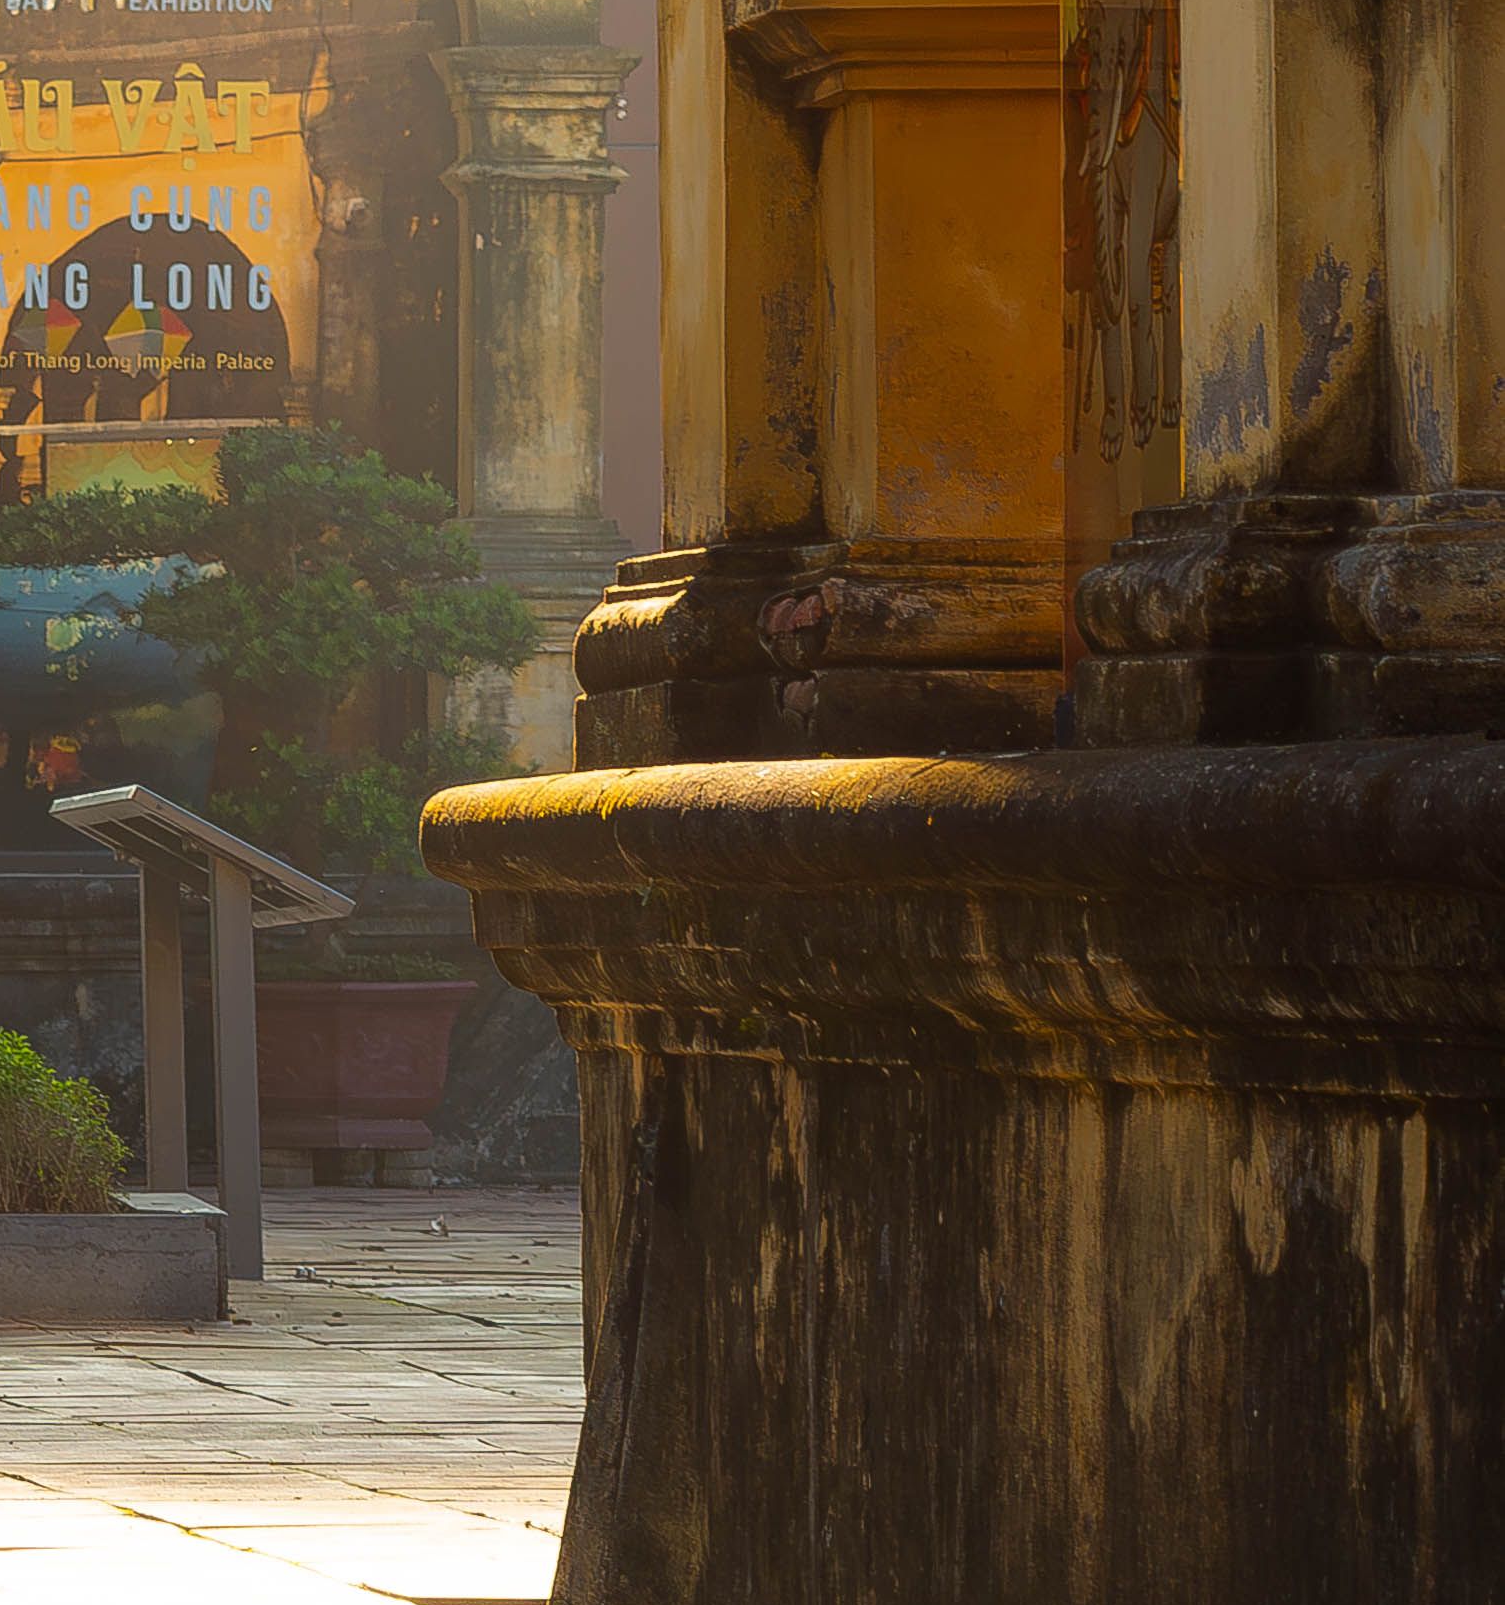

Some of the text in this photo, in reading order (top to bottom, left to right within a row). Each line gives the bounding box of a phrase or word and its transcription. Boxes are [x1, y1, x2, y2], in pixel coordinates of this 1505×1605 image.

[101, 62, 270, 171] VẬT
[130, 185, 272, 233] CUNG
[132, 262, 272, 311] LONG
[24, 351, 81, 374] Thang
[85, 352, 132, 374] Long
[216, 351, 275, 371] Palace
